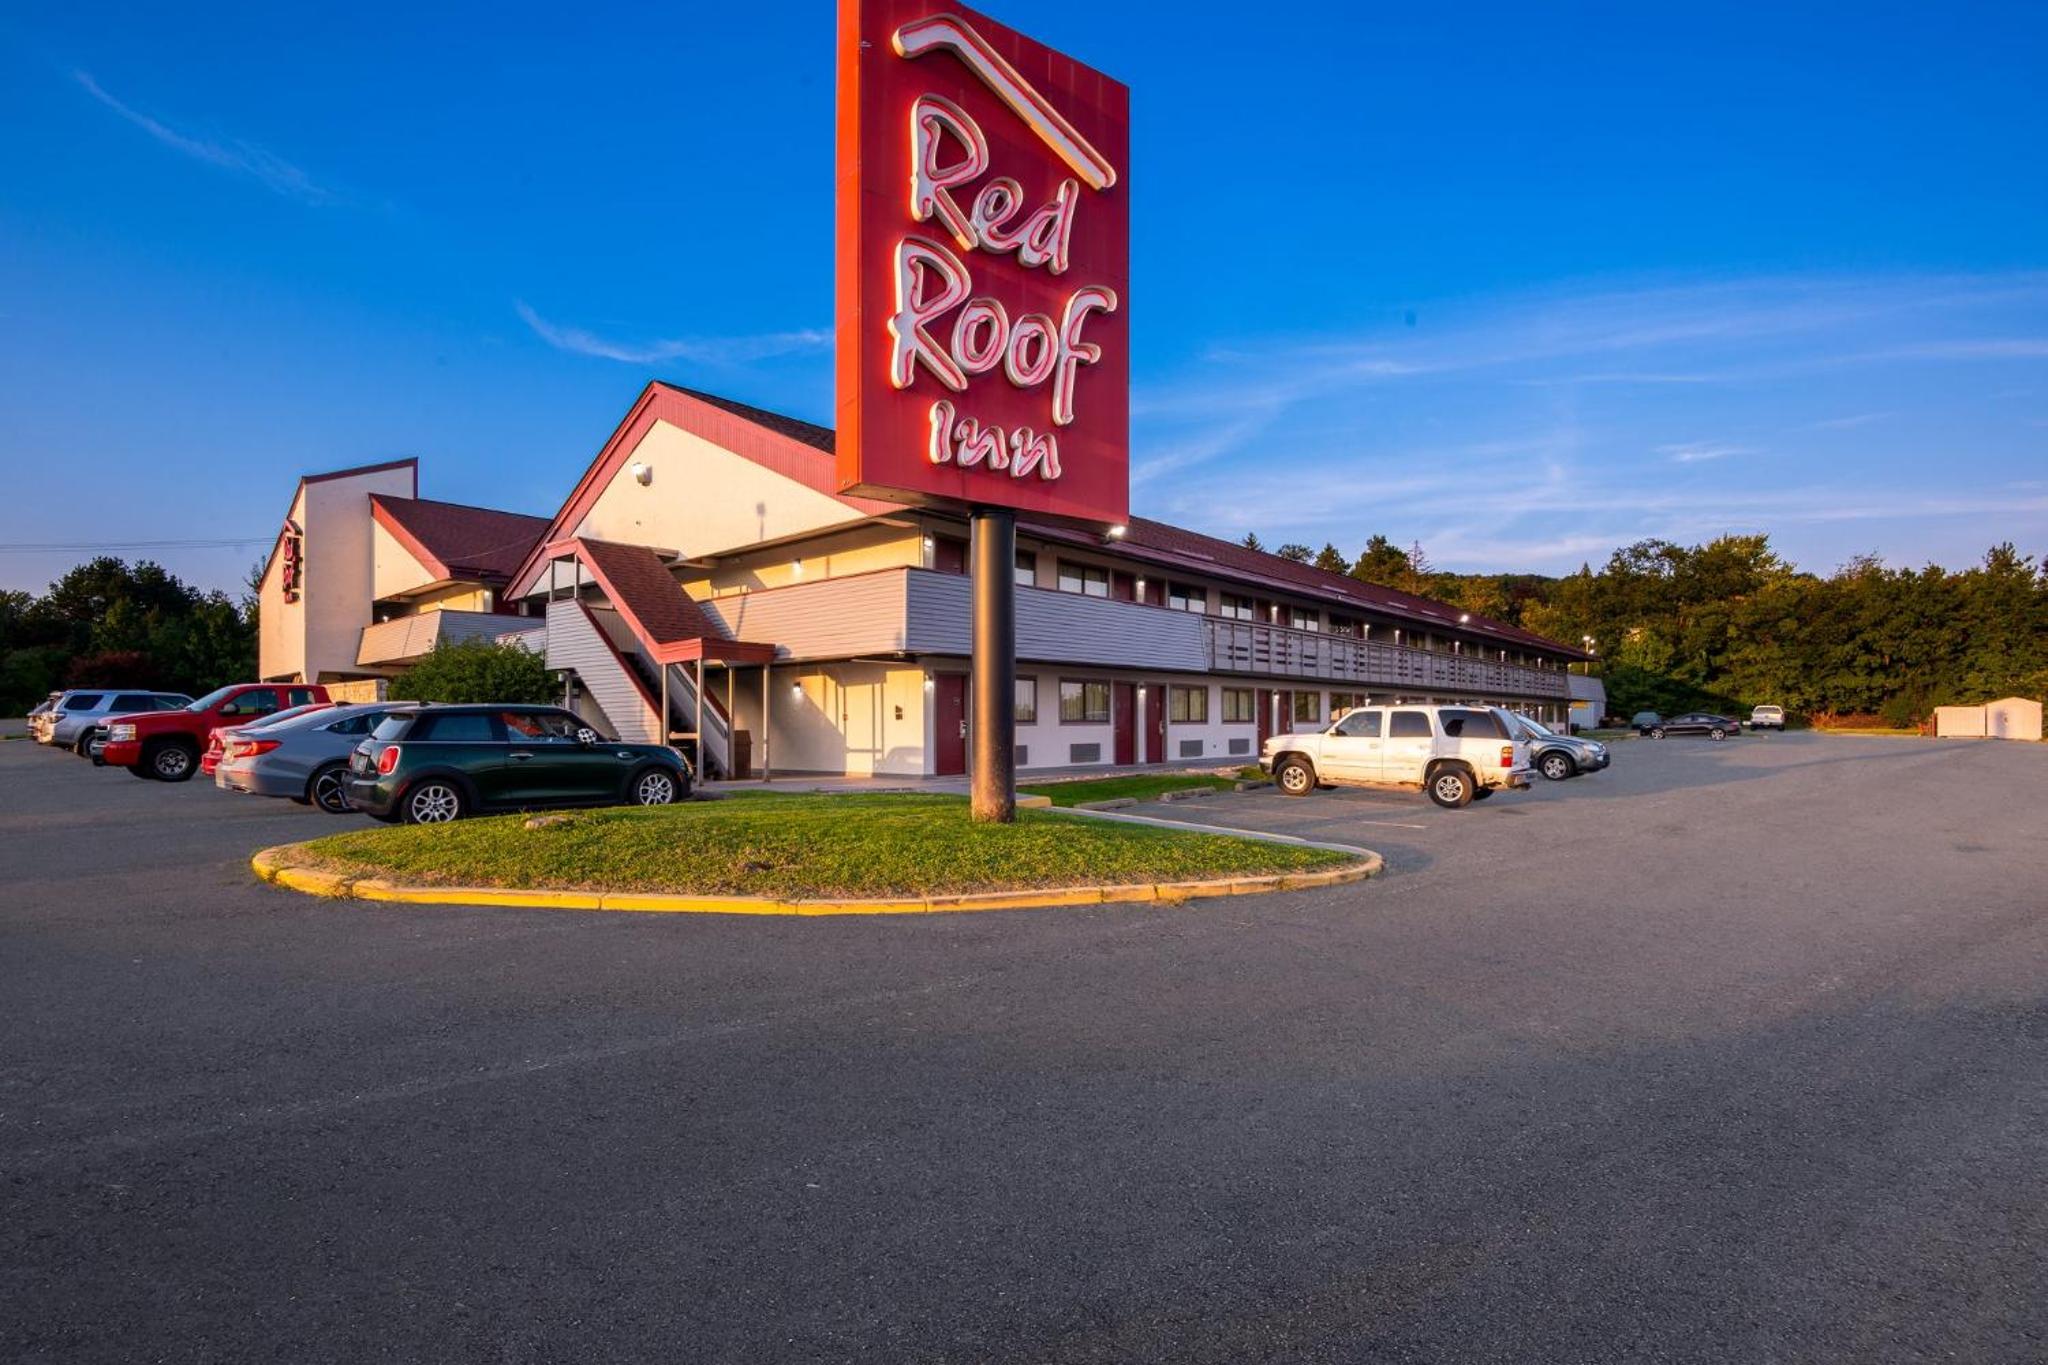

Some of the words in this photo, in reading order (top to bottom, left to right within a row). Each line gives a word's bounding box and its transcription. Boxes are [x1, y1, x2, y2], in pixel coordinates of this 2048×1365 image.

[910, 94, 1079, 275] Red
[888, 236, 1118, 425] Roof
[929, 400, 1061, 480] Inn
